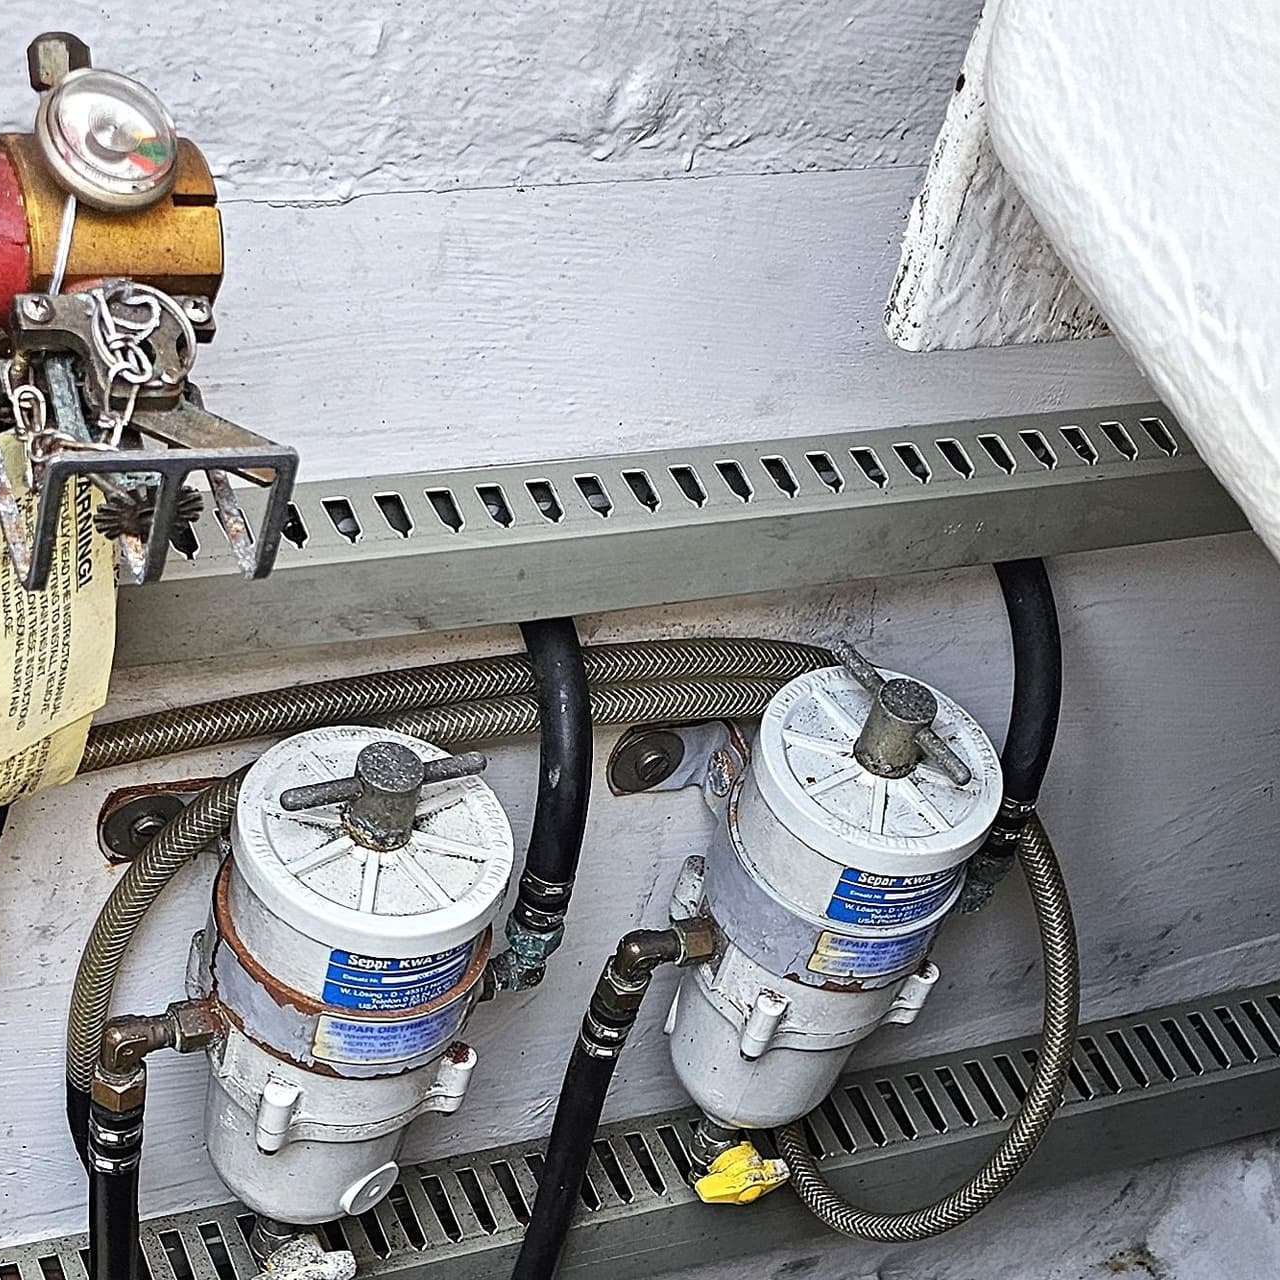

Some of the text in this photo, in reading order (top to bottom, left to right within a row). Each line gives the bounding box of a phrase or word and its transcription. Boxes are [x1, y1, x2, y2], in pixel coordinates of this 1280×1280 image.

[76, 479, 91, 588] ARNING!
[60, 542, 69, 575] READ
[61, 576, 70, 603] THE
[14, 594, 23, 651] PERSONAL
[49, 607, 60, 624] TO
[37, 626, 49, 654] THIS
[59, 605, 71, 675] INSTRUCTION
[858, 872, 932, 886] Separ KWA
[347, 954, 433, 969] Separ KWA
[330, 1021, 374, 1034] SEPAR
